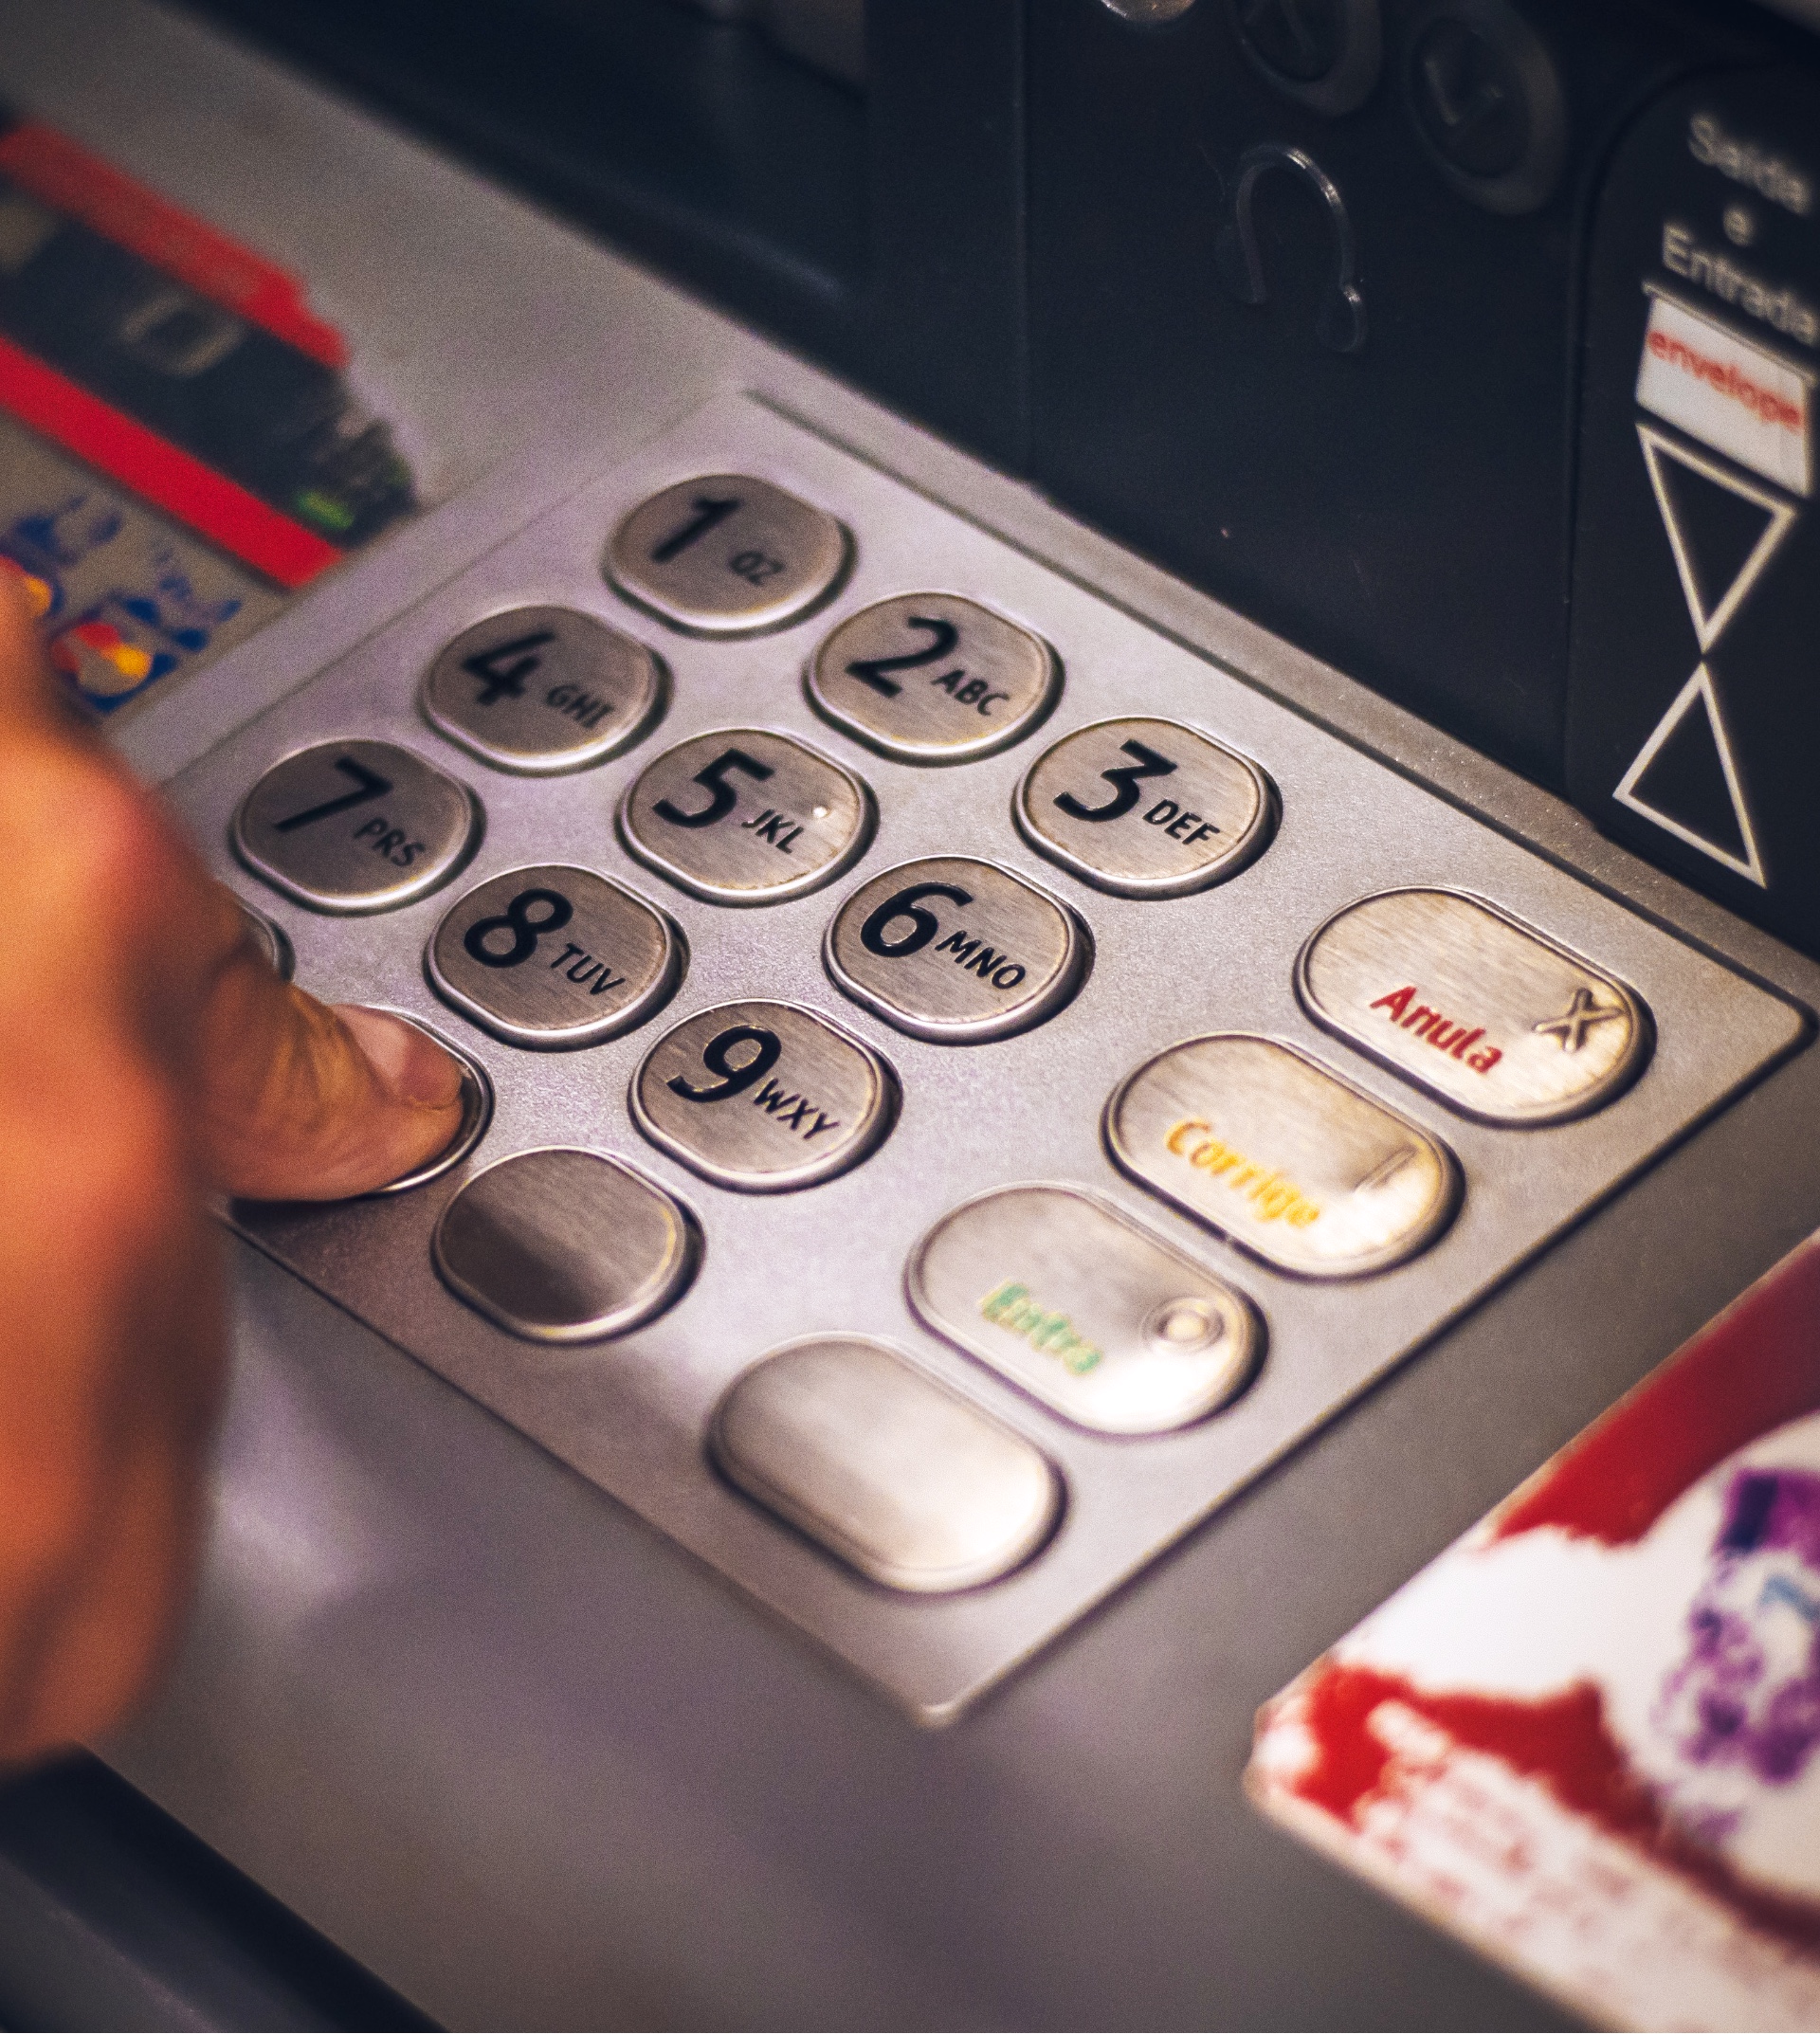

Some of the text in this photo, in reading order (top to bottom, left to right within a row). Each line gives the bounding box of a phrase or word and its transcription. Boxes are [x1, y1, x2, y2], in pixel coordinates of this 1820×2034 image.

[1662, 223, 1819, 347] Entrada
[1647, 329, 1803, 435] envelope
[651, 495, 743, 563] 1
[463, 629, 616, 729] 4 GHI
[845, 616, 1010, 717] 2 ABC
[273, 757, 427, 866] 7 PRS
[651, 748, 804, 855] 5 JKL
[1052, 739, 1222, 846] 3 DEF
[463, 887, 626, 996] 8 TUV
[860, 881, 1027, 990] 6 MNO
[665, 1024, 842, 1140] 9 WXY
[1370, 985, 1503, 1075] Anula
[1166, 1118, 1321, 1231] Corrige
[979, 1280, 1102, 1378] Entra
